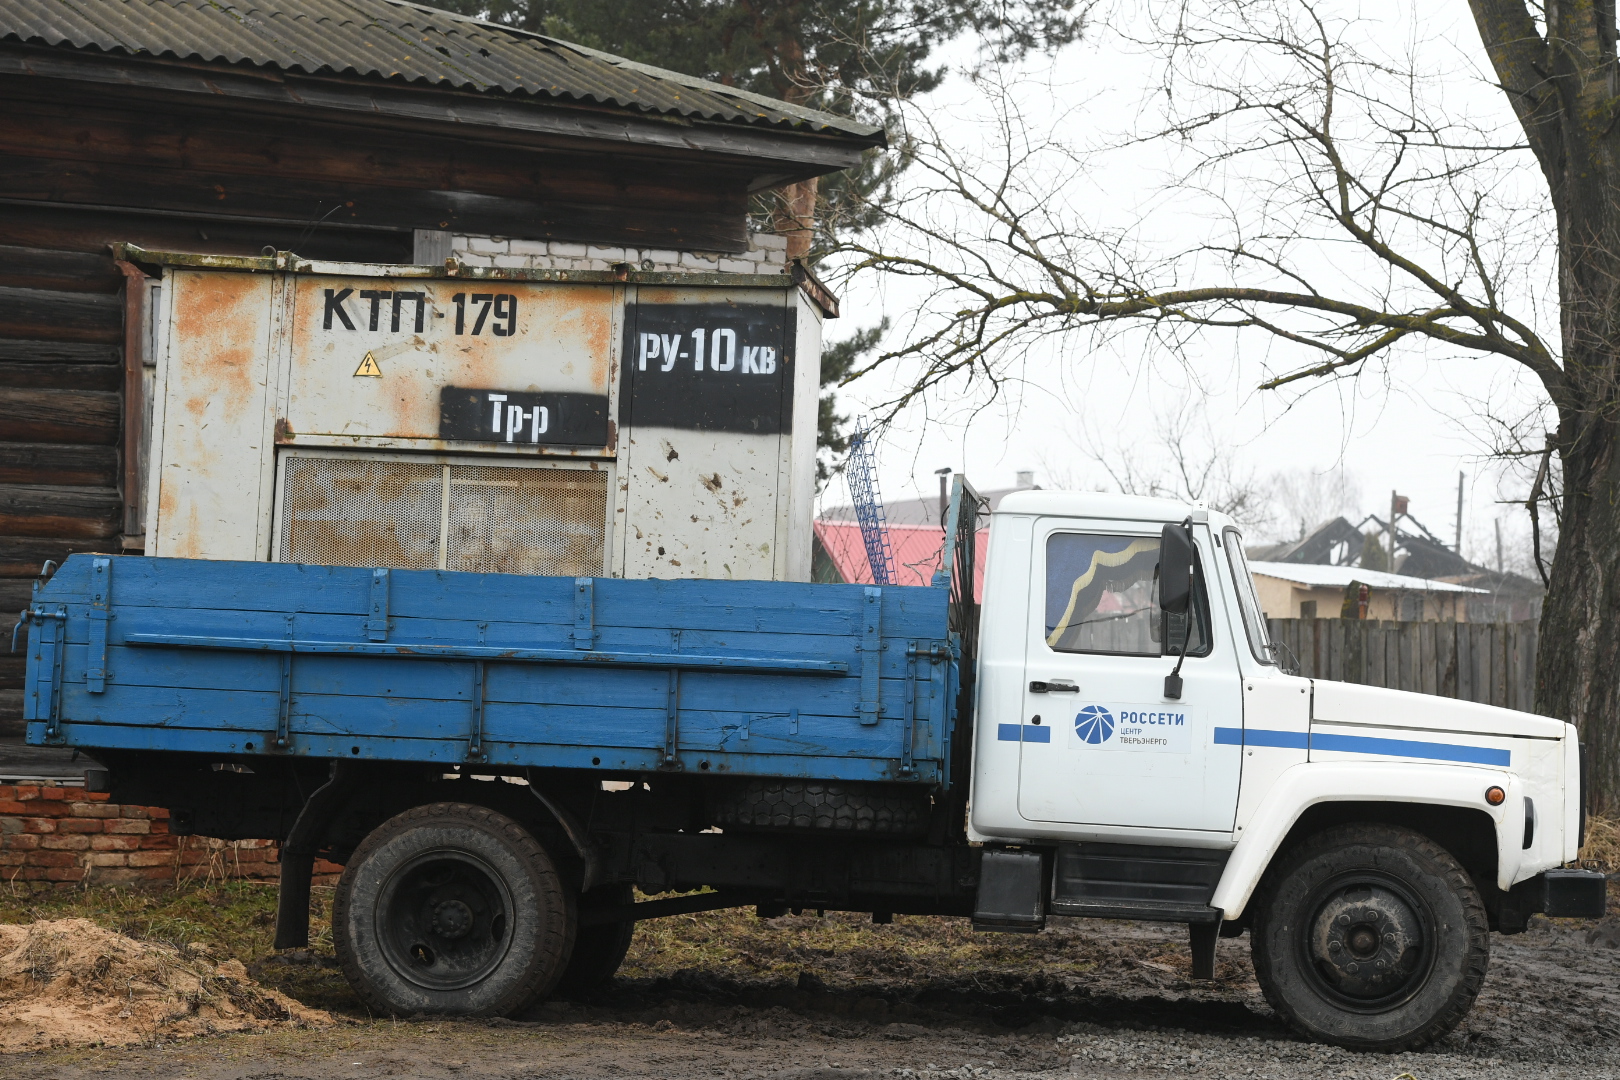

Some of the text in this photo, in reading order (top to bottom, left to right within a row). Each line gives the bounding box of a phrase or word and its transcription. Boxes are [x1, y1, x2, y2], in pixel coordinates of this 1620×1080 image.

[488, 393, 549, 443] Тр-р
[1120, 711, 1184, 726] РОССЕТИ
[1120, 736, 1167, 746] ТВЕРЬЭНЕРГО
